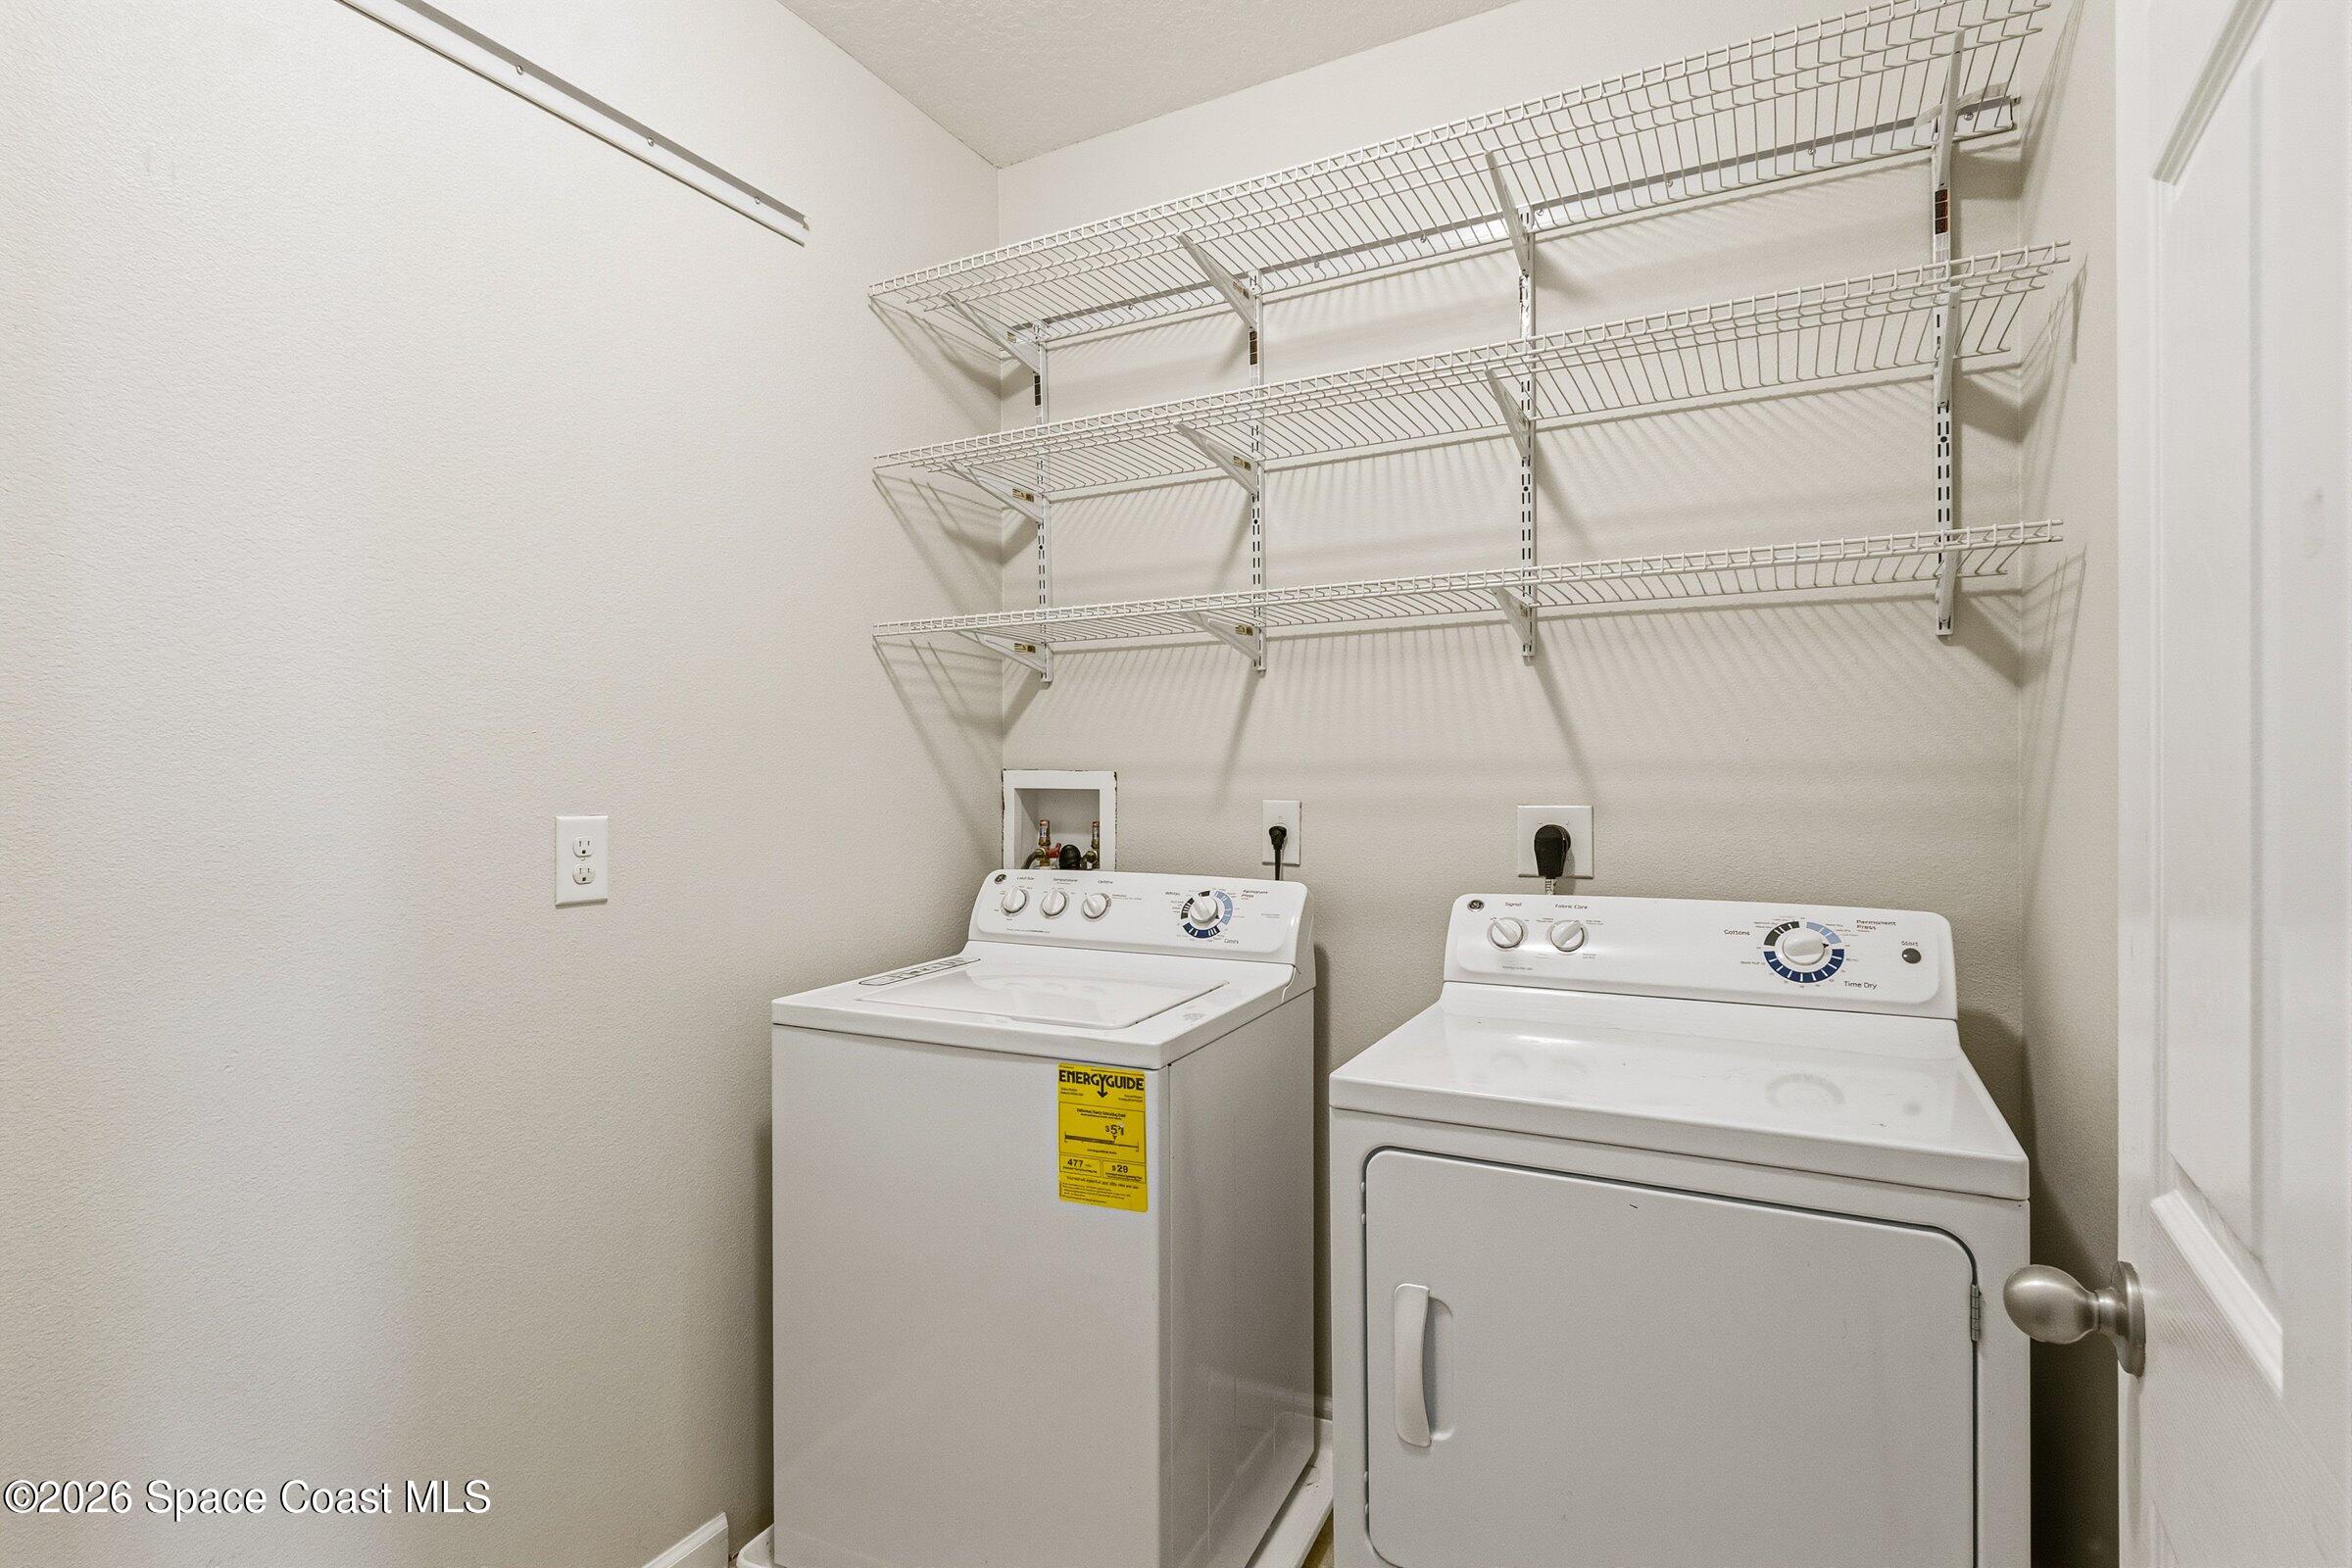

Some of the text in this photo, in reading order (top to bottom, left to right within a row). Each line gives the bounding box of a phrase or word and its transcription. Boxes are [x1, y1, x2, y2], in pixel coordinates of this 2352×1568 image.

[1723, 928, 1750, 937] Cottons
[1843, 980, 1862, 989] Time
[1863, 982, 1878, 991] Dry
[1058, 1069, 1145, 1092] ENERGYGUIDE
